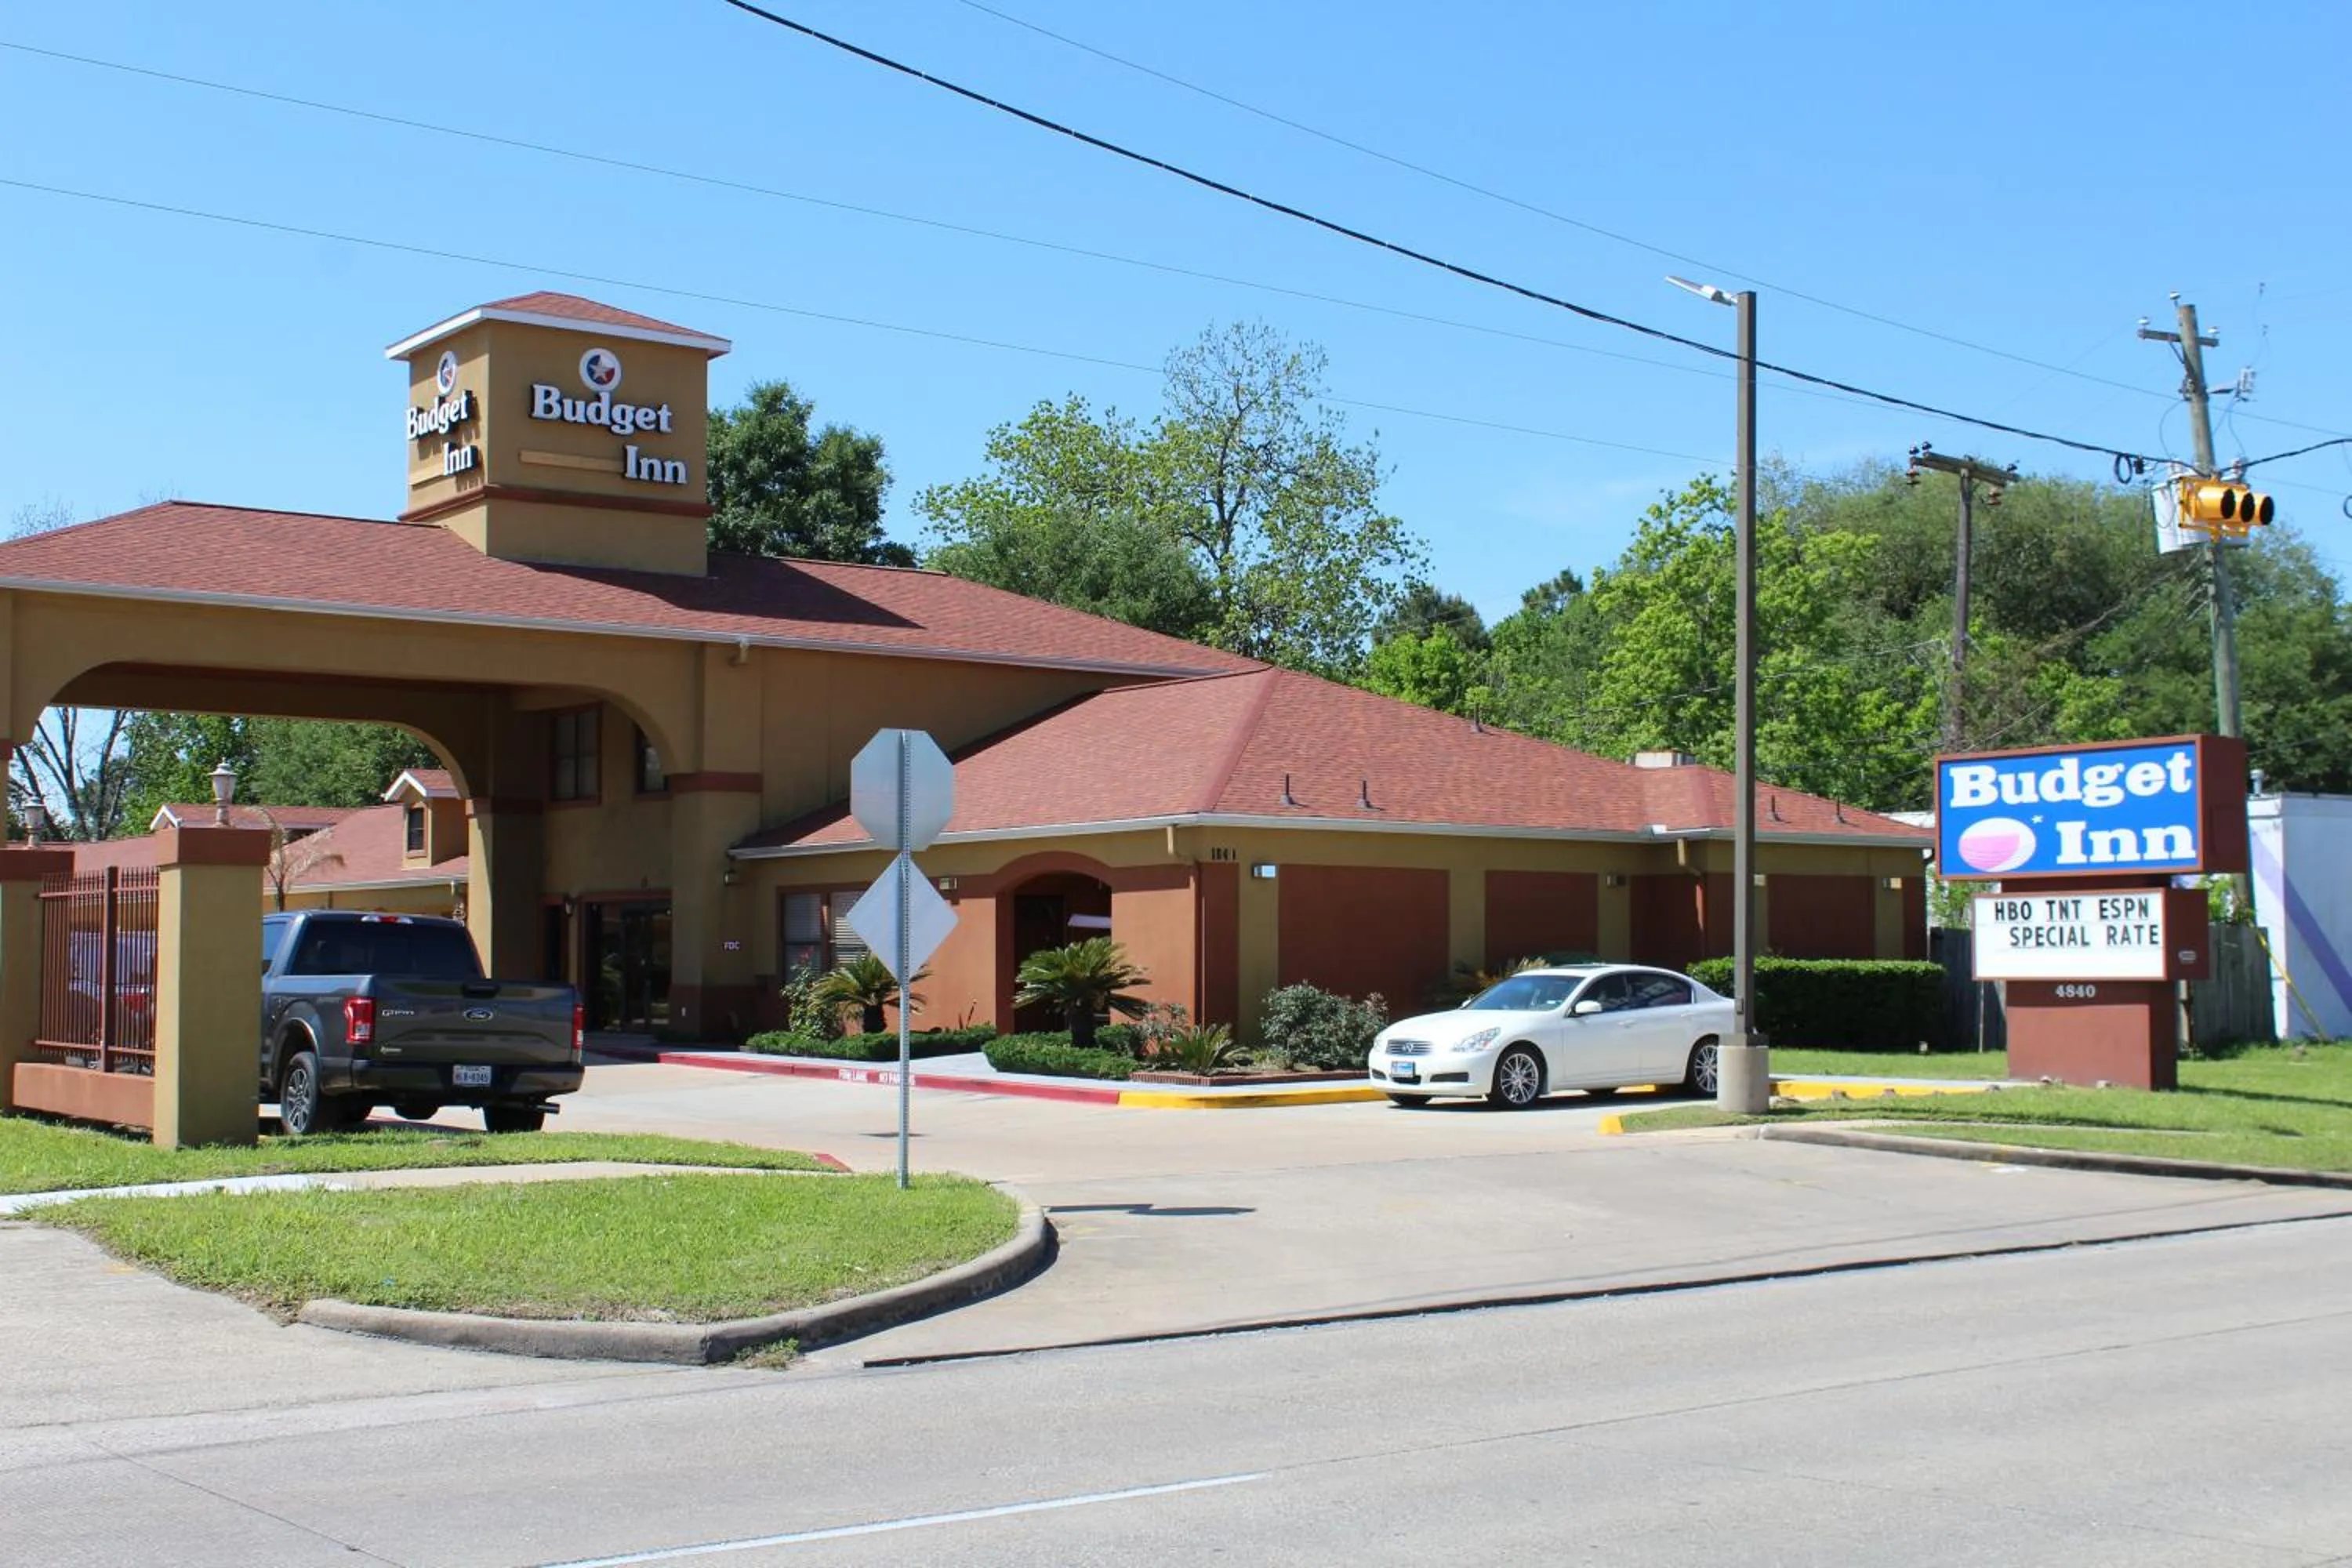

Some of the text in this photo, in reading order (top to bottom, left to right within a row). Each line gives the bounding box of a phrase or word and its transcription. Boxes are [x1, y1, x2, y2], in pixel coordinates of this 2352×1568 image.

[405, 390, 469, 441] Budget
[532, 383, 673, 435] Budget
[443, 441, 473, 477] Inn
[624, 444, 688, 485] Inn
[1949, 751, 2193, 808] Budget
[2056, 820, 2197, 865] Inn
[1994, 898, 2150, 921] HBO TNT ESPN
[2009, 924, 2160, 947] SPECIAL RATE
[2055, 984, 2096, 998] 4840
